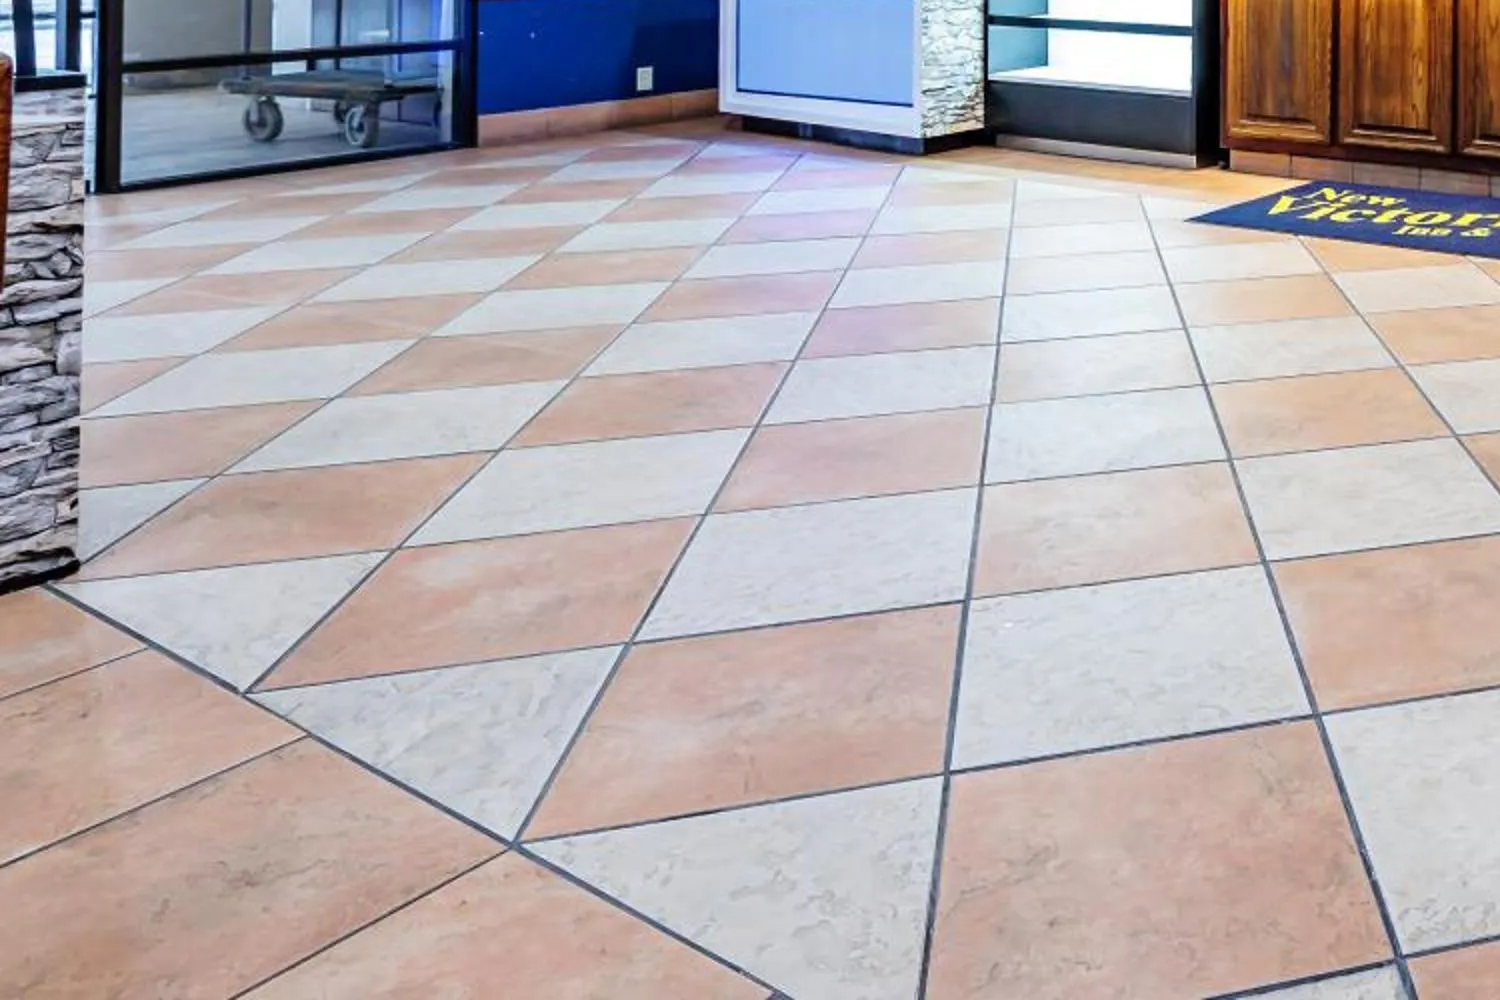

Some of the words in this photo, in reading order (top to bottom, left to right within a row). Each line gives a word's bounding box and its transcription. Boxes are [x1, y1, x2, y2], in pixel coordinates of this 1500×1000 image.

[1302, 186, 1406, 206] New
[1392, 225, 1452, 236] Inn
[1460, 227, 1492, 237] &
